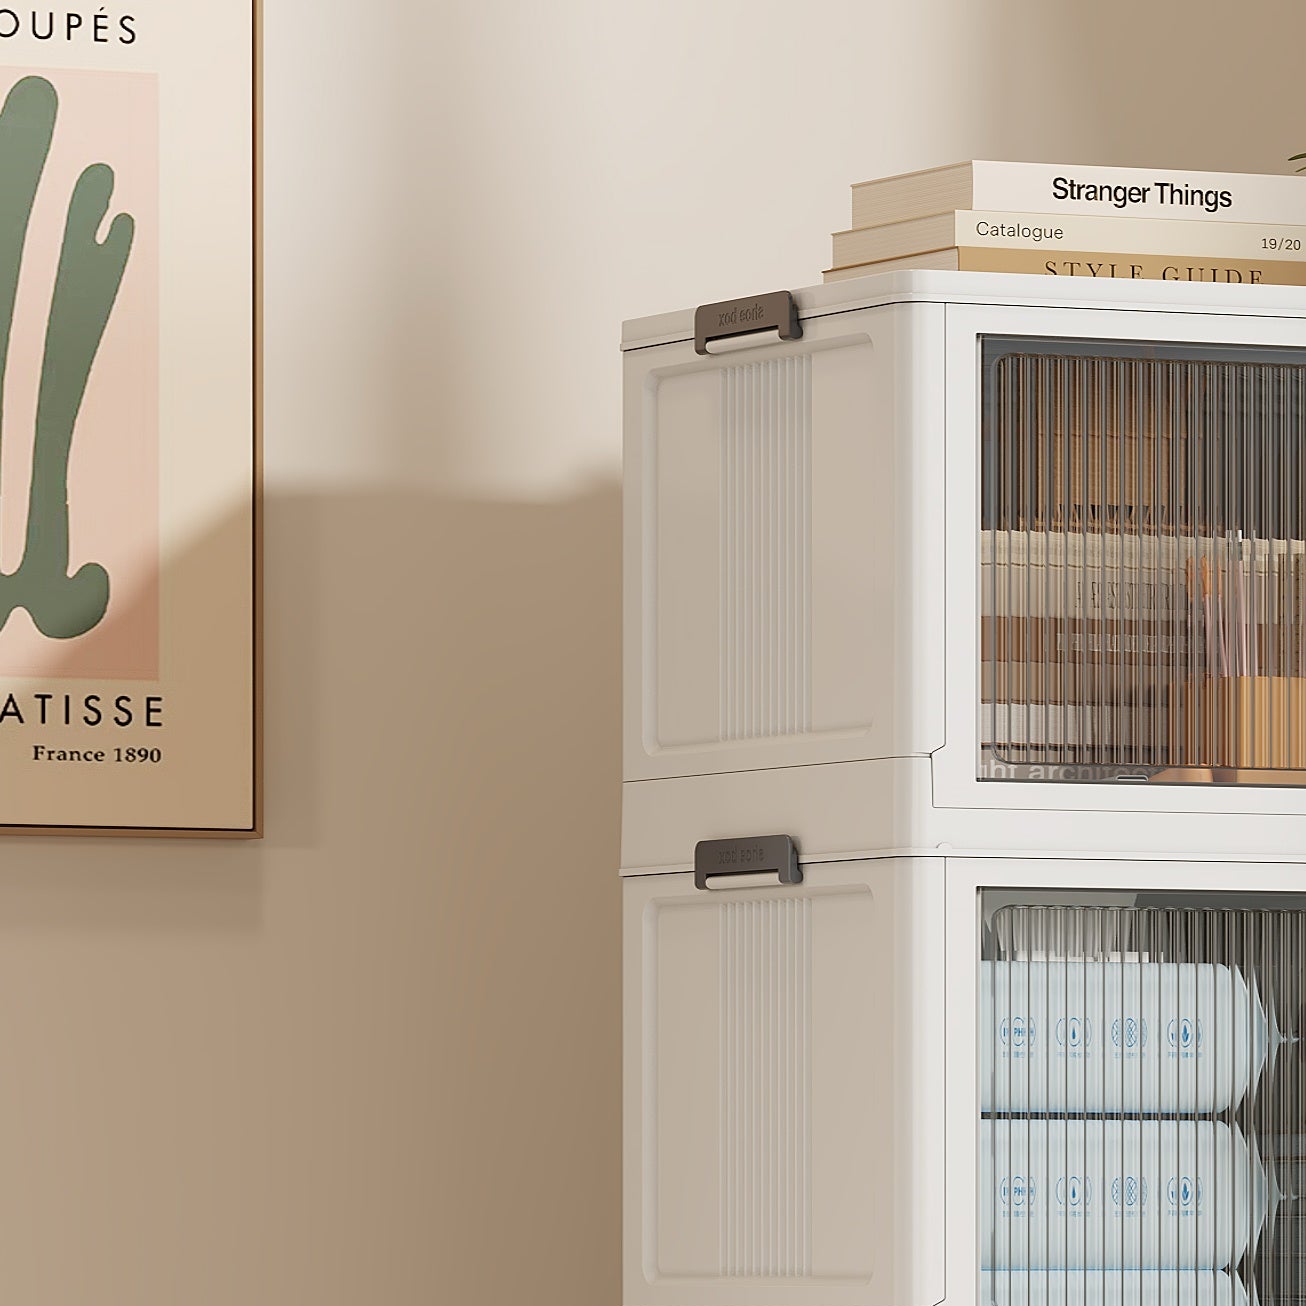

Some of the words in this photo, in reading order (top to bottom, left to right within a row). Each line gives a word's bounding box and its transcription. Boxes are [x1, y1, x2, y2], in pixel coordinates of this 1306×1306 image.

[0, 7, 136, 44] OUPÉS
[1052, 177, 1150, 208] Stranger
[1154, 183, 1233, 213] Things
[976, 221, 1064, 242] Catalogue
[1261, 237, 1302, 251] 19/20
[0, 693, 163, 727] ATISSE
[32, 745, 106, 762] France
[113, 747, 162, 763] 1890
